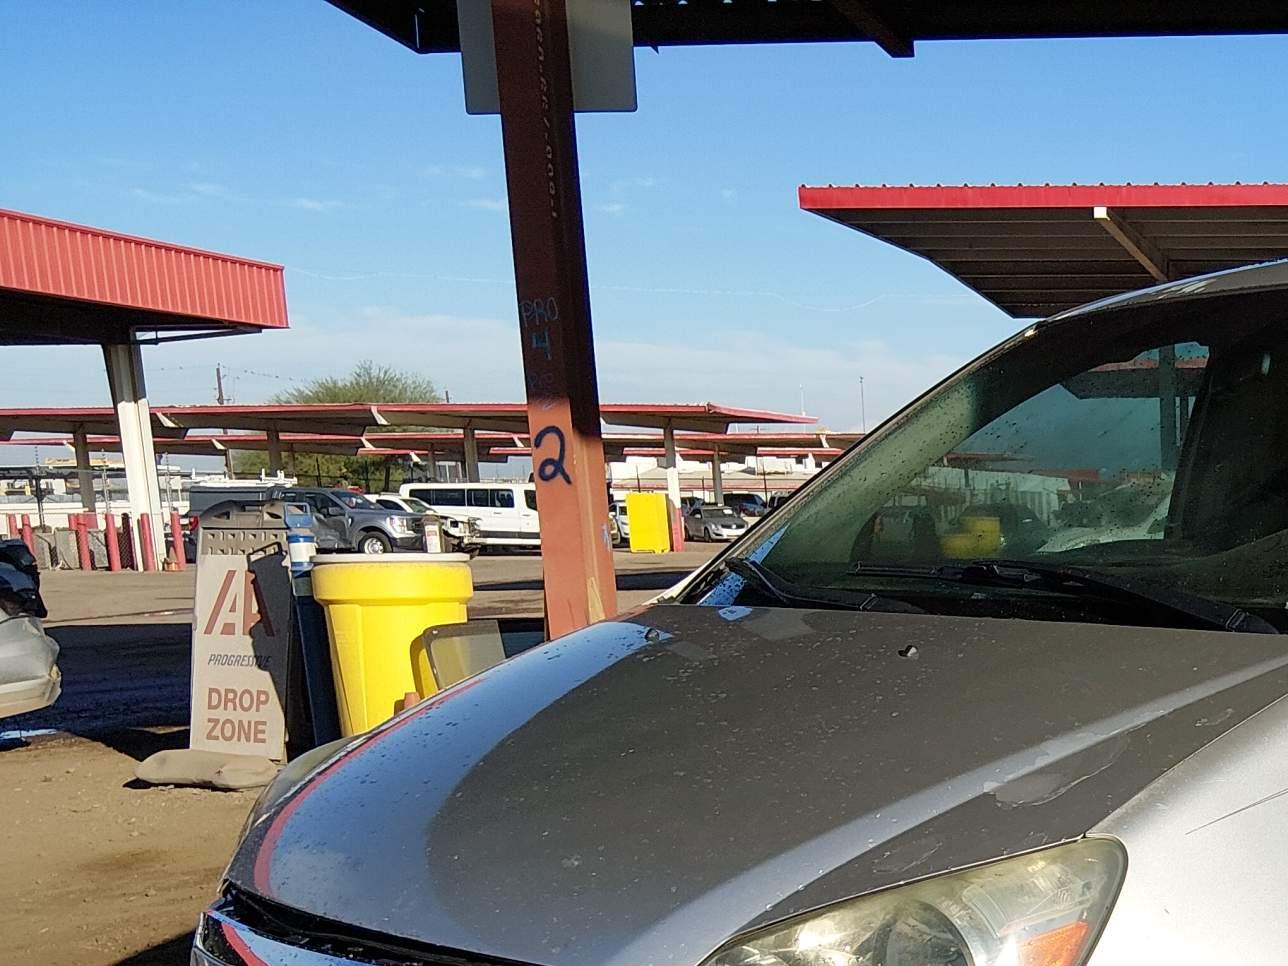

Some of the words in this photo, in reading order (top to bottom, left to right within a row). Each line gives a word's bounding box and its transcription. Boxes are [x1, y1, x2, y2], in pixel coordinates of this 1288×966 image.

[533, 425, 572, 485] 2
[207, 653, 272, 669] PROGRESSIVE
[207, 687, 270, 712] DROP
[206, 717, 267, 744] ZONE
